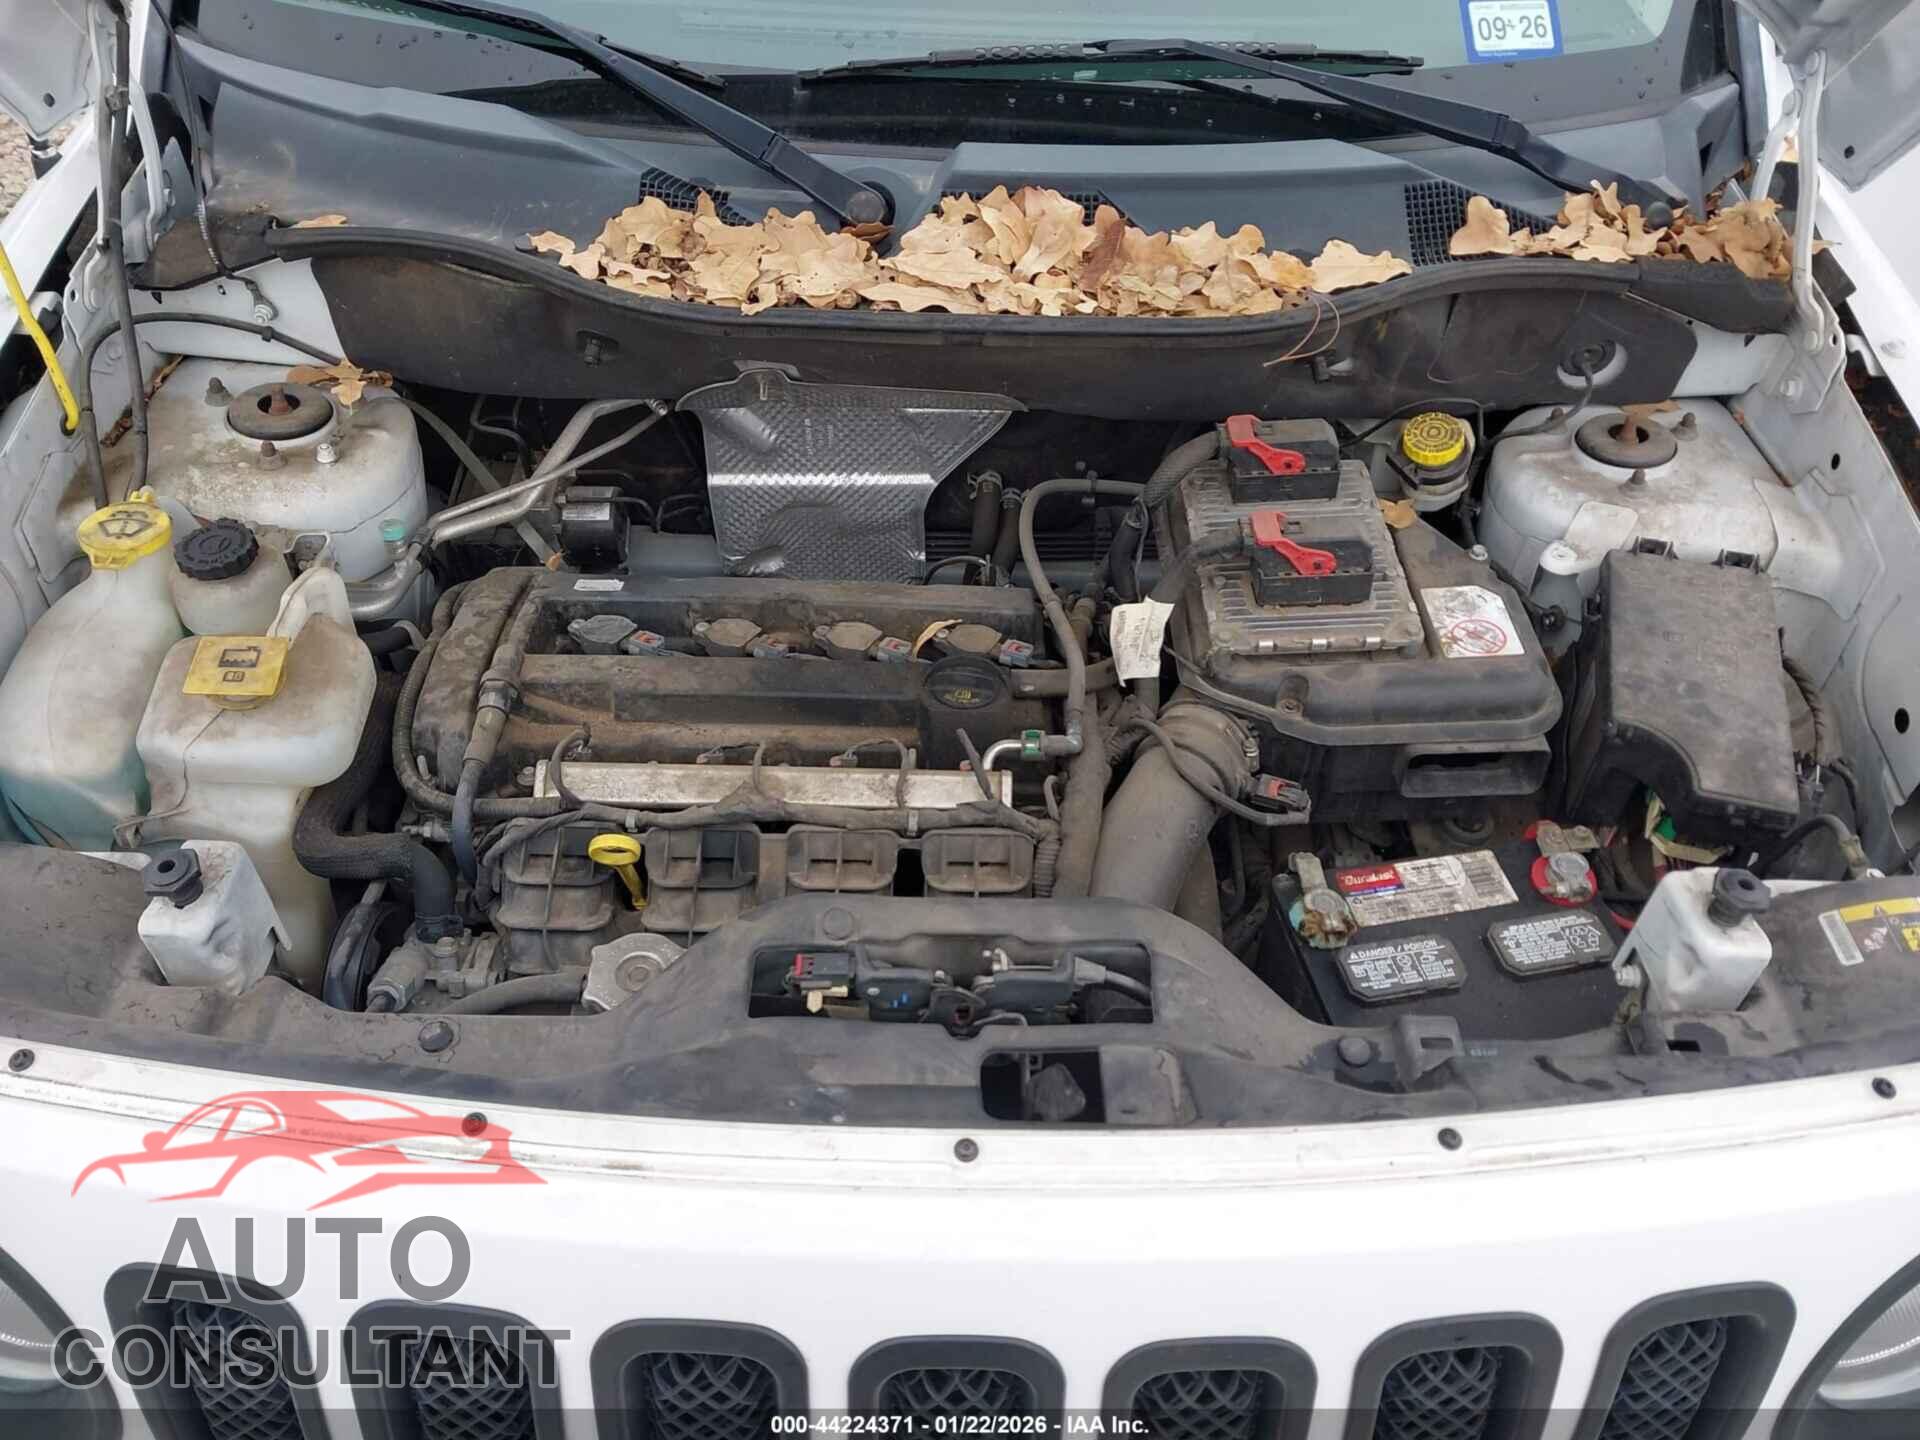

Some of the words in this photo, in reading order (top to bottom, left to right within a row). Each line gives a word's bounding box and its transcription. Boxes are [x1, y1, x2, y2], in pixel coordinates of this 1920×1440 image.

[1478, 16, 1507, 41] 09
[1519, 15, 1547, 38] 26
[1358, 945, 1396, 960] DANGER
